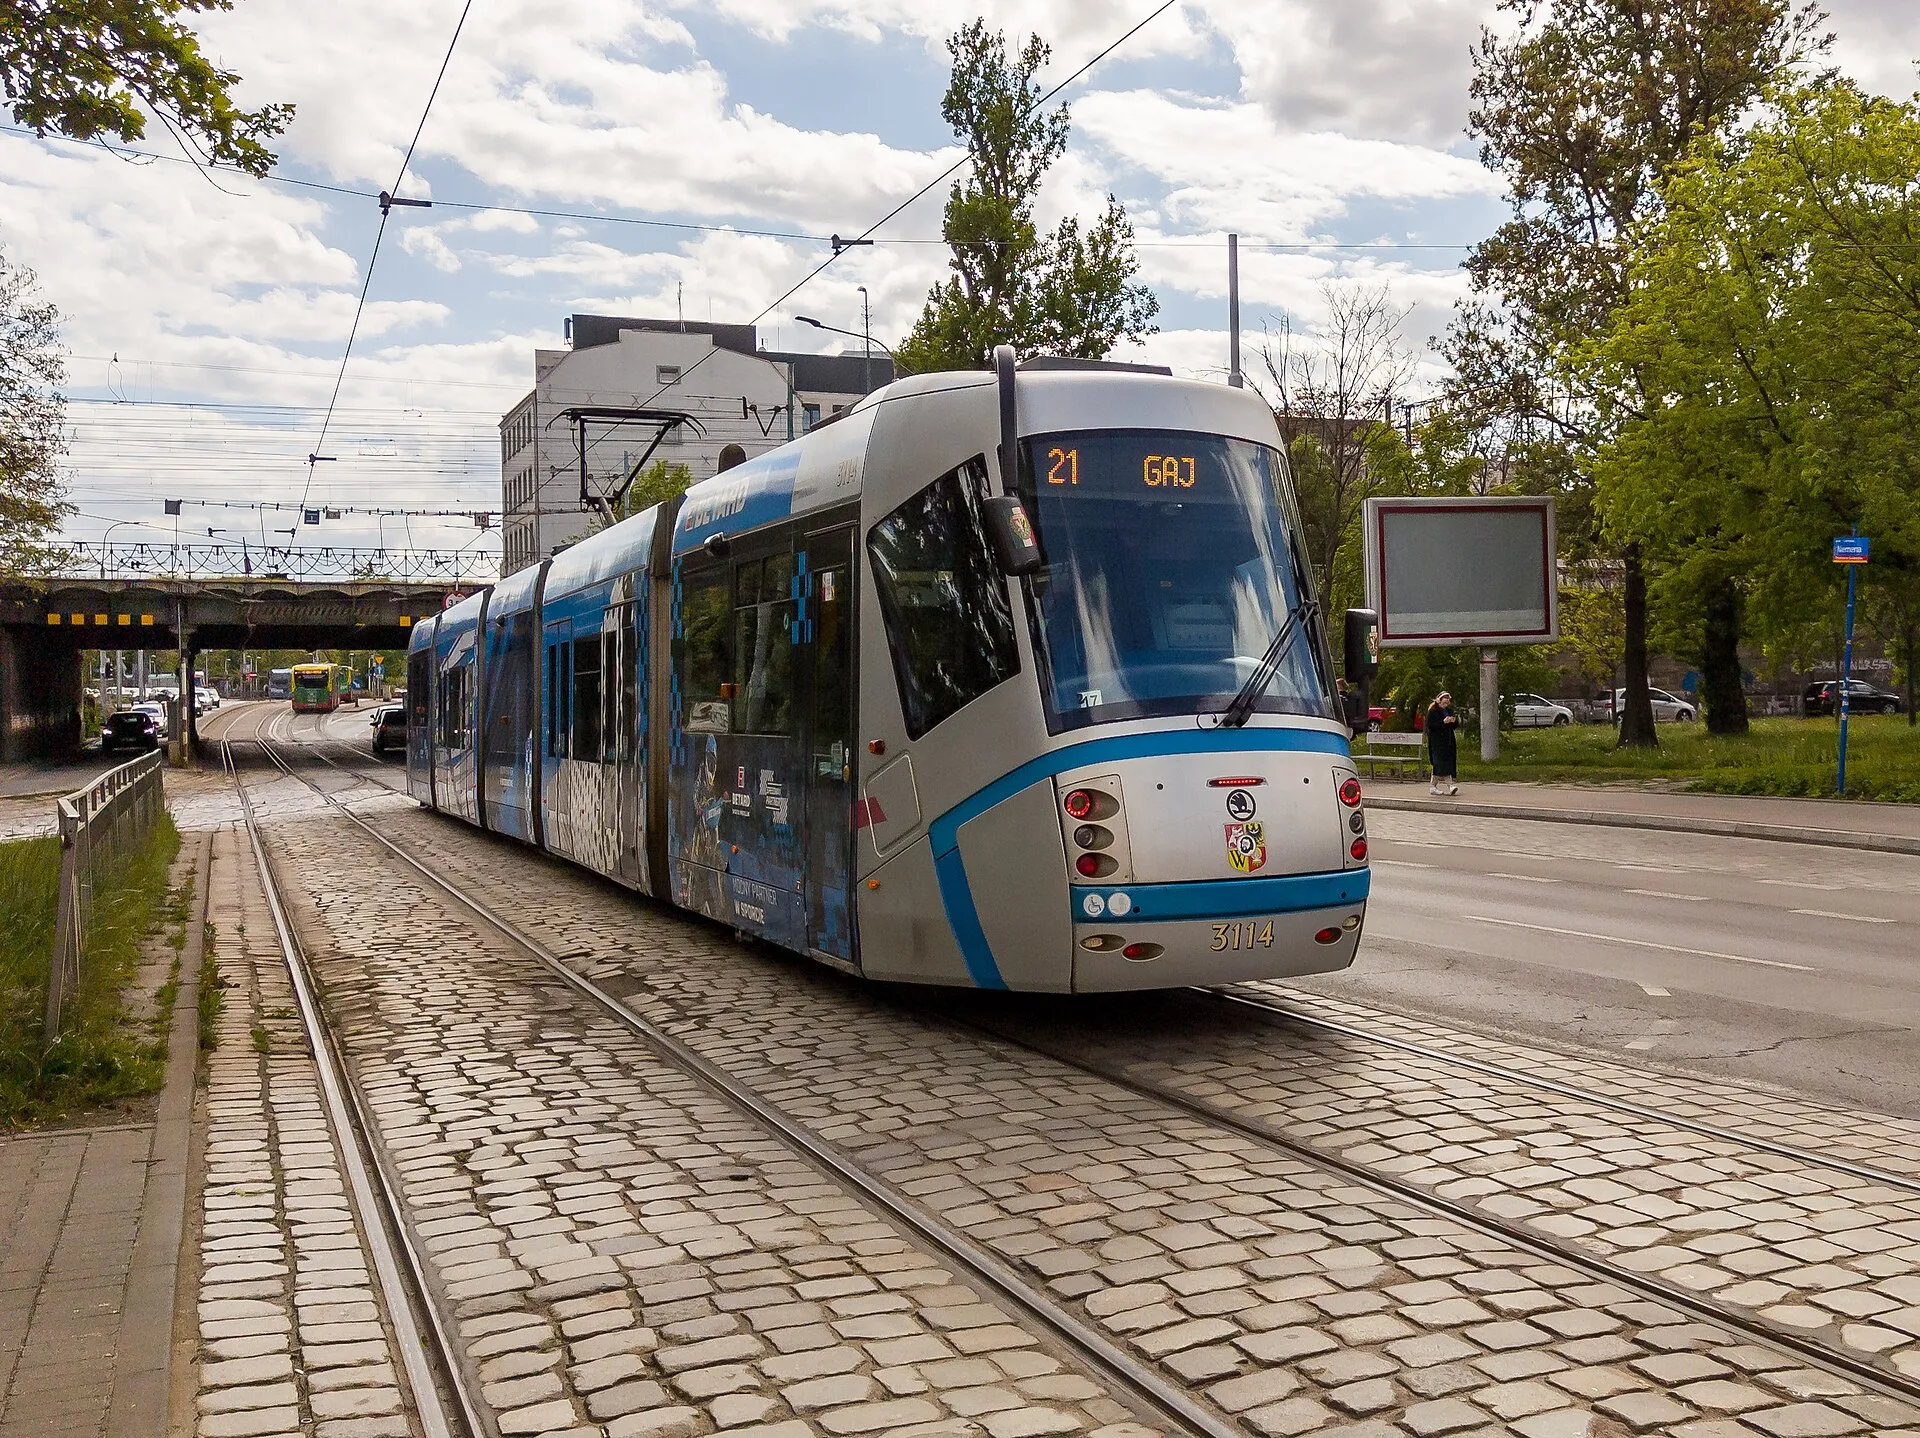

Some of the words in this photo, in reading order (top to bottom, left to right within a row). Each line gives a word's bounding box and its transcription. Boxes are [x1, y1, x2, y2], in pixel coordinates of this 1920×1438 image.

[1048, 448, 1078, 485] 21
[1143, 455, 1196, 488] GAJ
[1210, 920, 1275, 952] 3114
